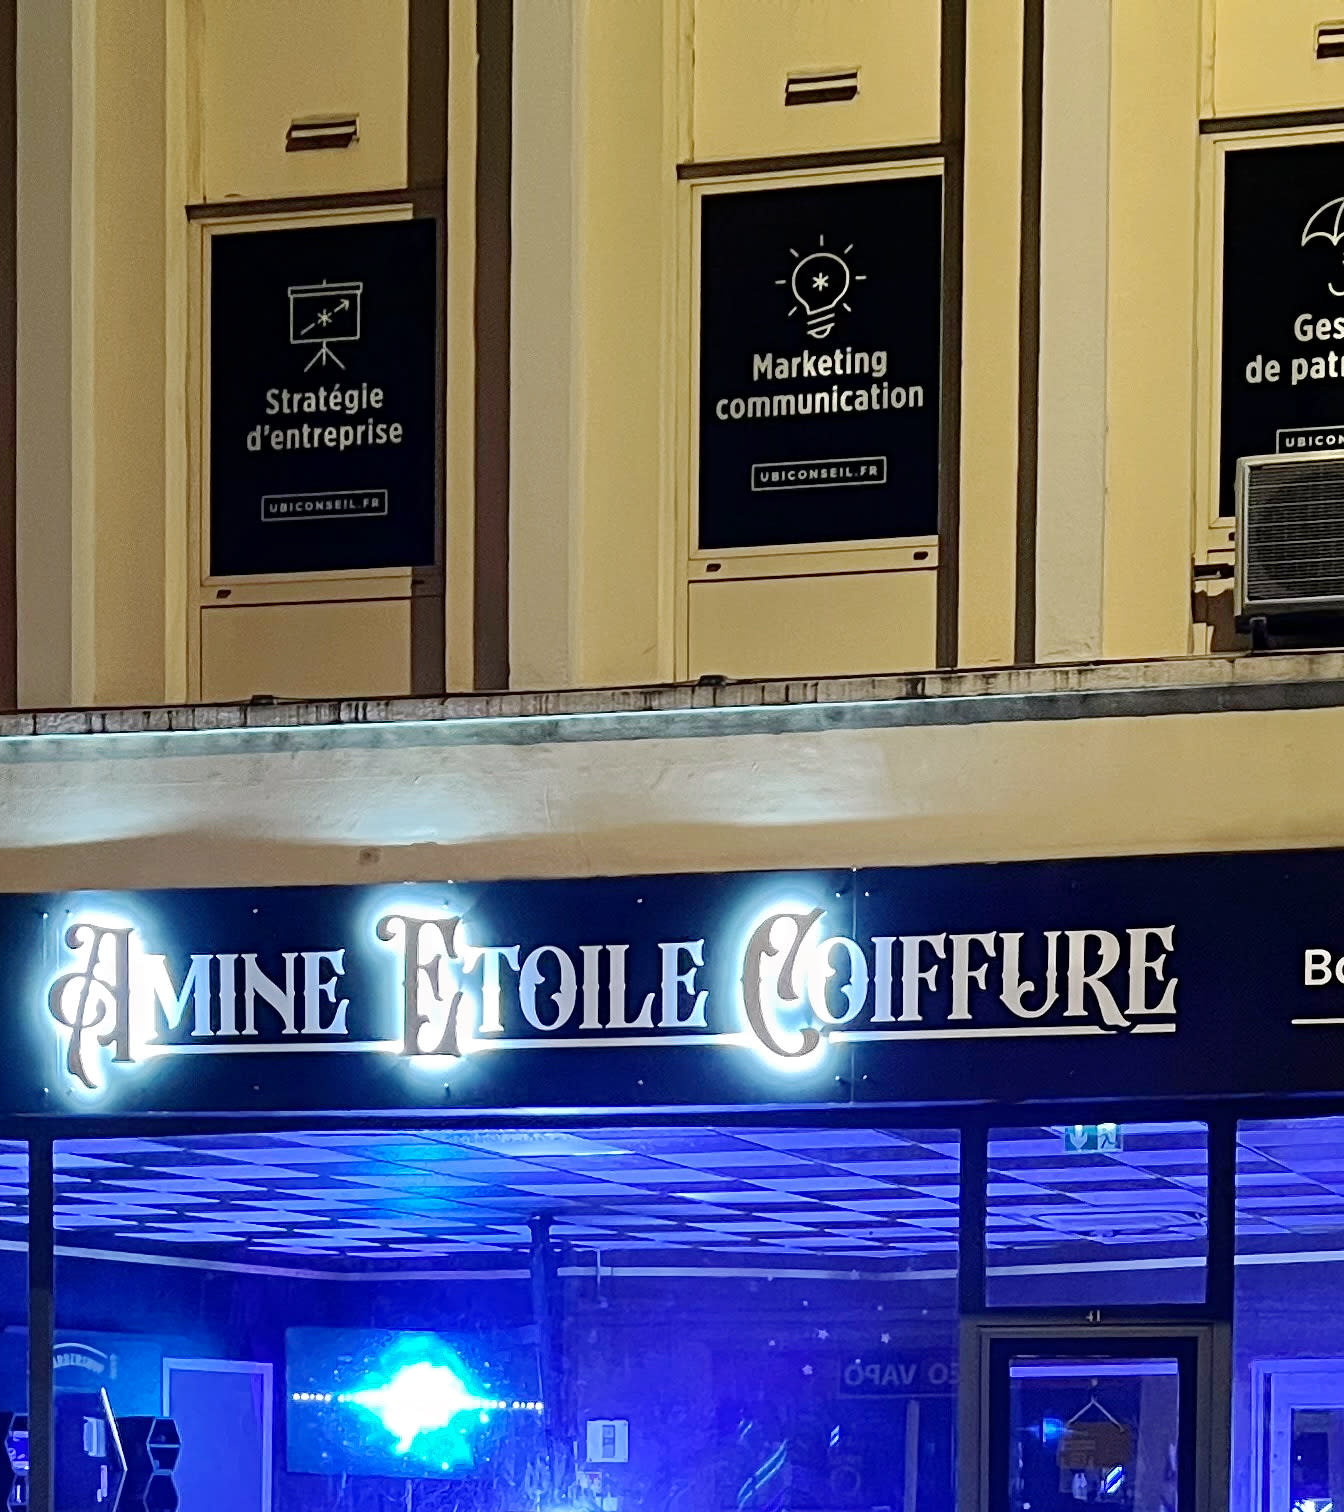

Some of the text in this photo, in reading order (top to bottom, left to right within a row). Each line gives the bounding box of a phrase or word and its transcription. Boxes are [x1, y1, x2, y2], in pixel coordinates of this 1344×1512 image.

[753, 346, 888, 382] Marketing
[1245, 354, 1281, 384] de
[265, 382, 384, 415] Stratégie
[715, 381, 924, 420] communication
[246, 418, 403, 451] d'entreprise
[759, 465, 879, 483] UBICONSEIL.FR
[268, 497, 380, 514] UBICONSEIL.FR
[46, 907, 1179, 1090] AMINE ETOILE COIFFURE
